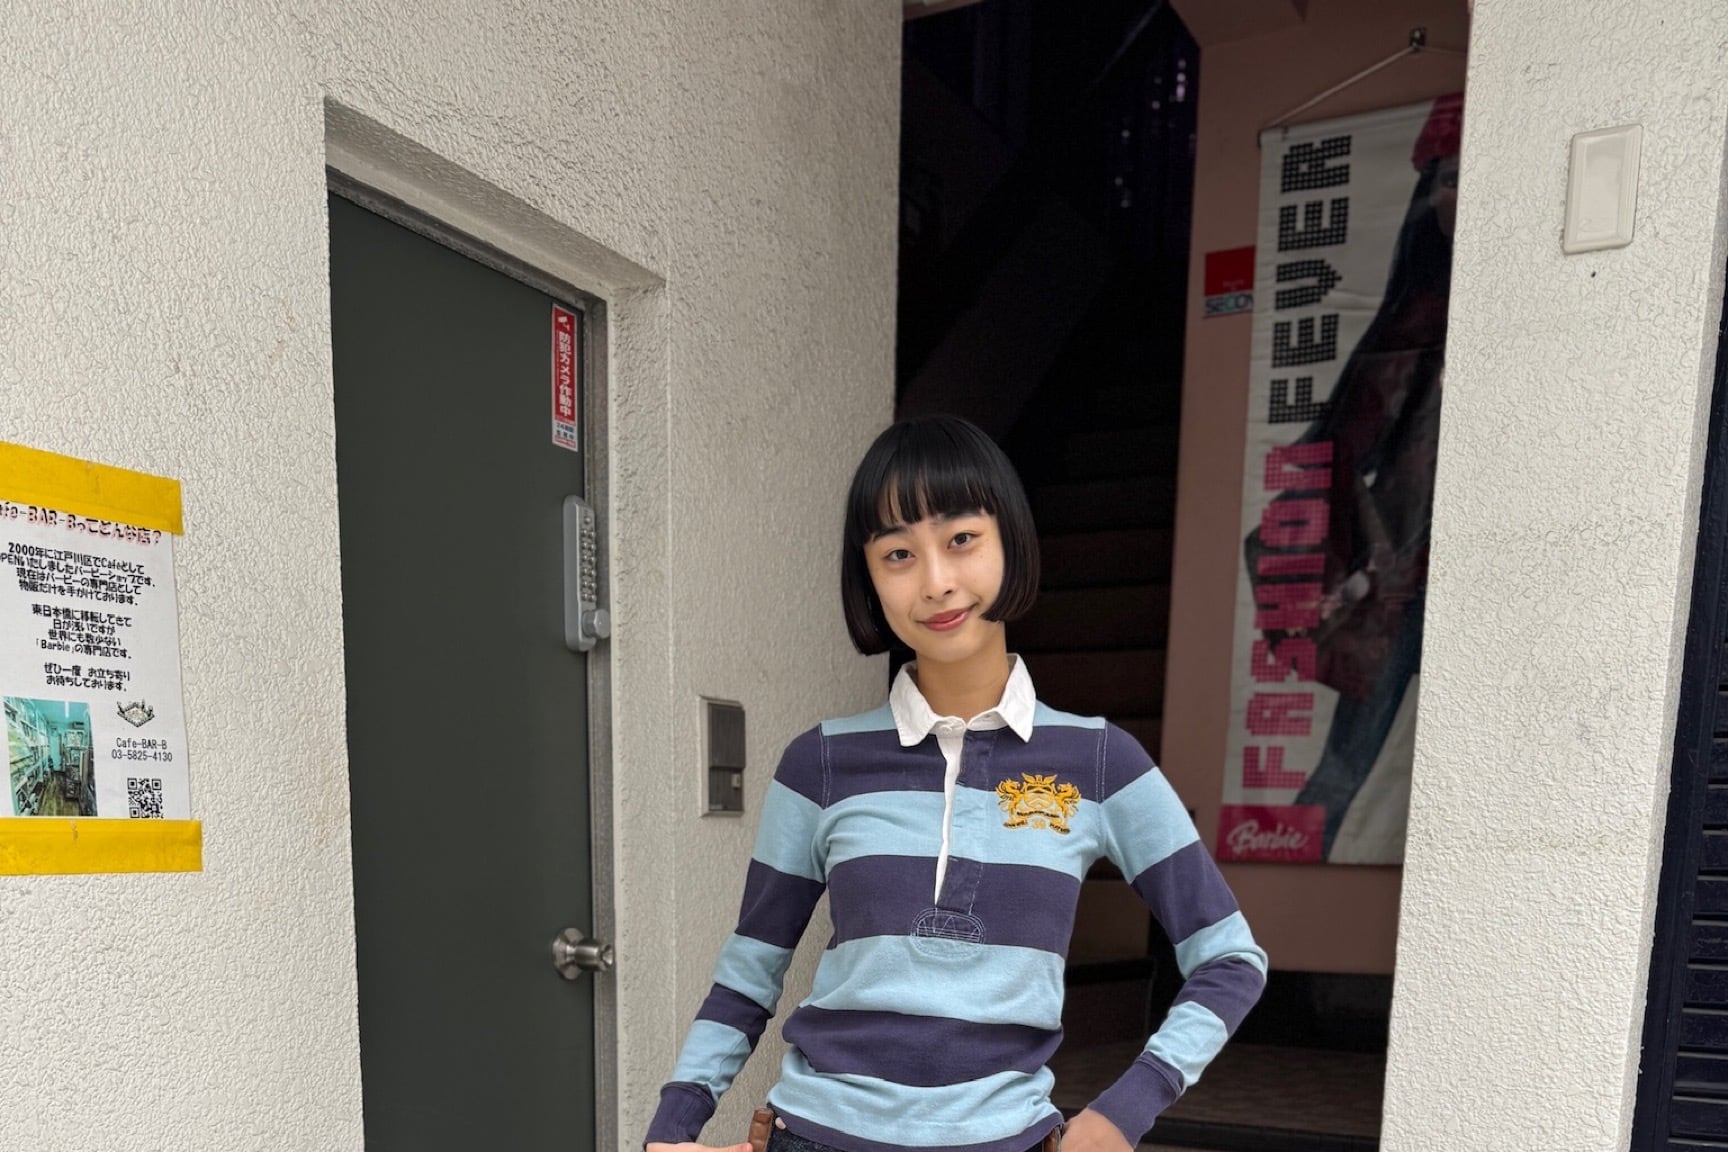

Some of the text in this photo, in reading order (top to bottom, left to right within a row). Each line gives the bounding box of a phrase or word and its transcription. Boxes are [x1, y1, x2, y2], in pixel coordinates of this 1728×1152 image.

[1268, 134, 1352, 425] FEVER
[1242, 440, 1335, 791] FASHION
[111, 750, 173, 762] 03-5825-4130
[116, 738, 168, 750] Cafe-BAR-B
[1226, 818, 1309, 855] Barbie
